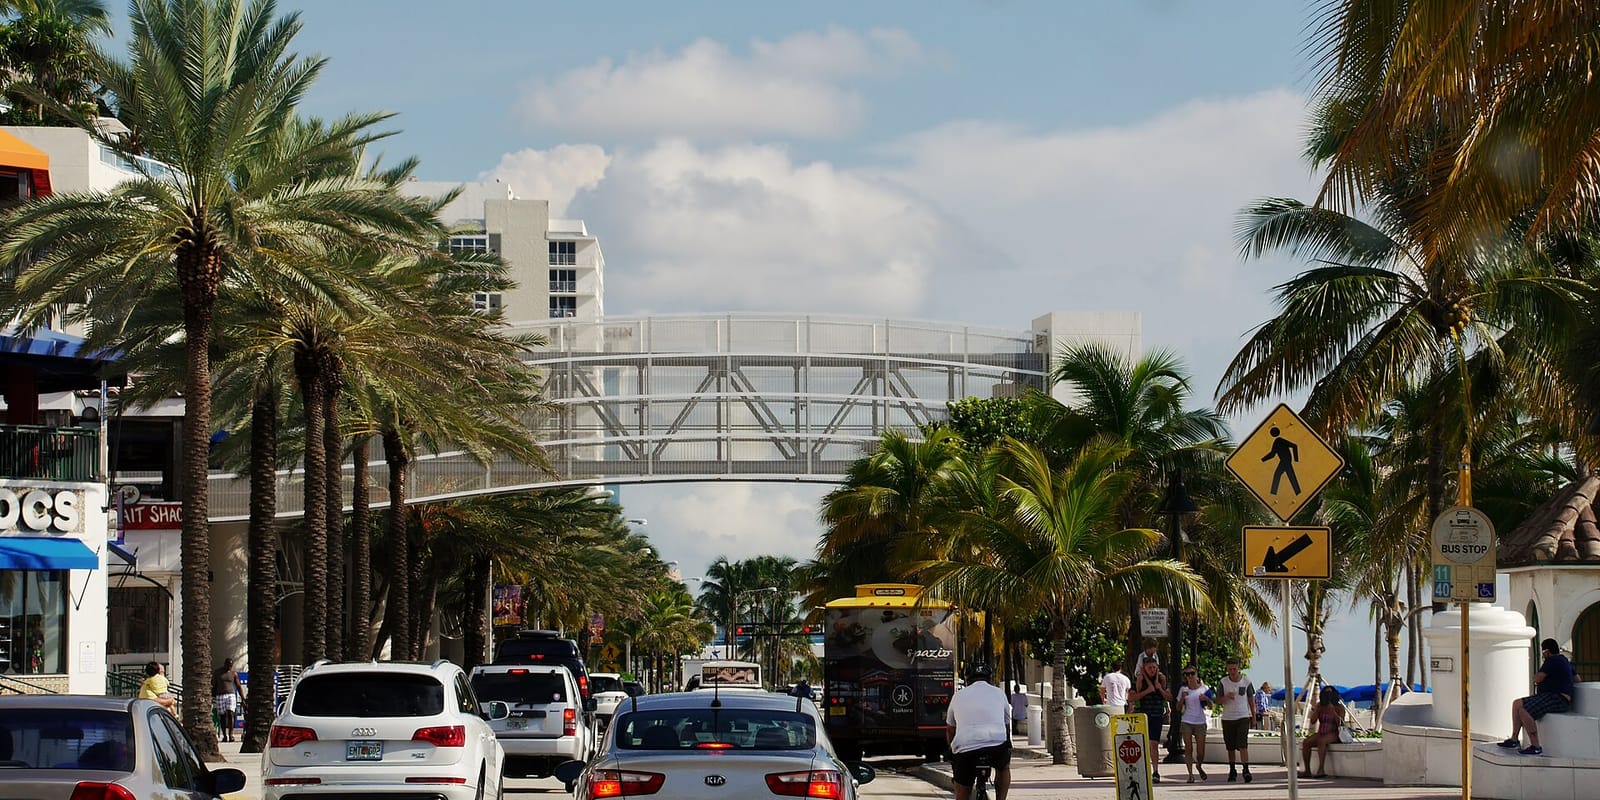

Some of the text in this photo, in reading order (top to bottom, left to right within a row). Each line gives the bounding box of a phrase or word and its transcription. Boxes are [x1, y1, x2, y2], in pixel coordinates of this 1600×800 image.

[1441, 544, 1488, 555] BUS STOP
[1435, 566, 1448, 580] 11
[1435, 583, 1450, 597] 40
[907, 646, 953, 665] spazio
[1119, 746, 1141, 757] STOP
[1125, 766, 1138, 774] FOR
[706, 776, 724, 785] KIA
